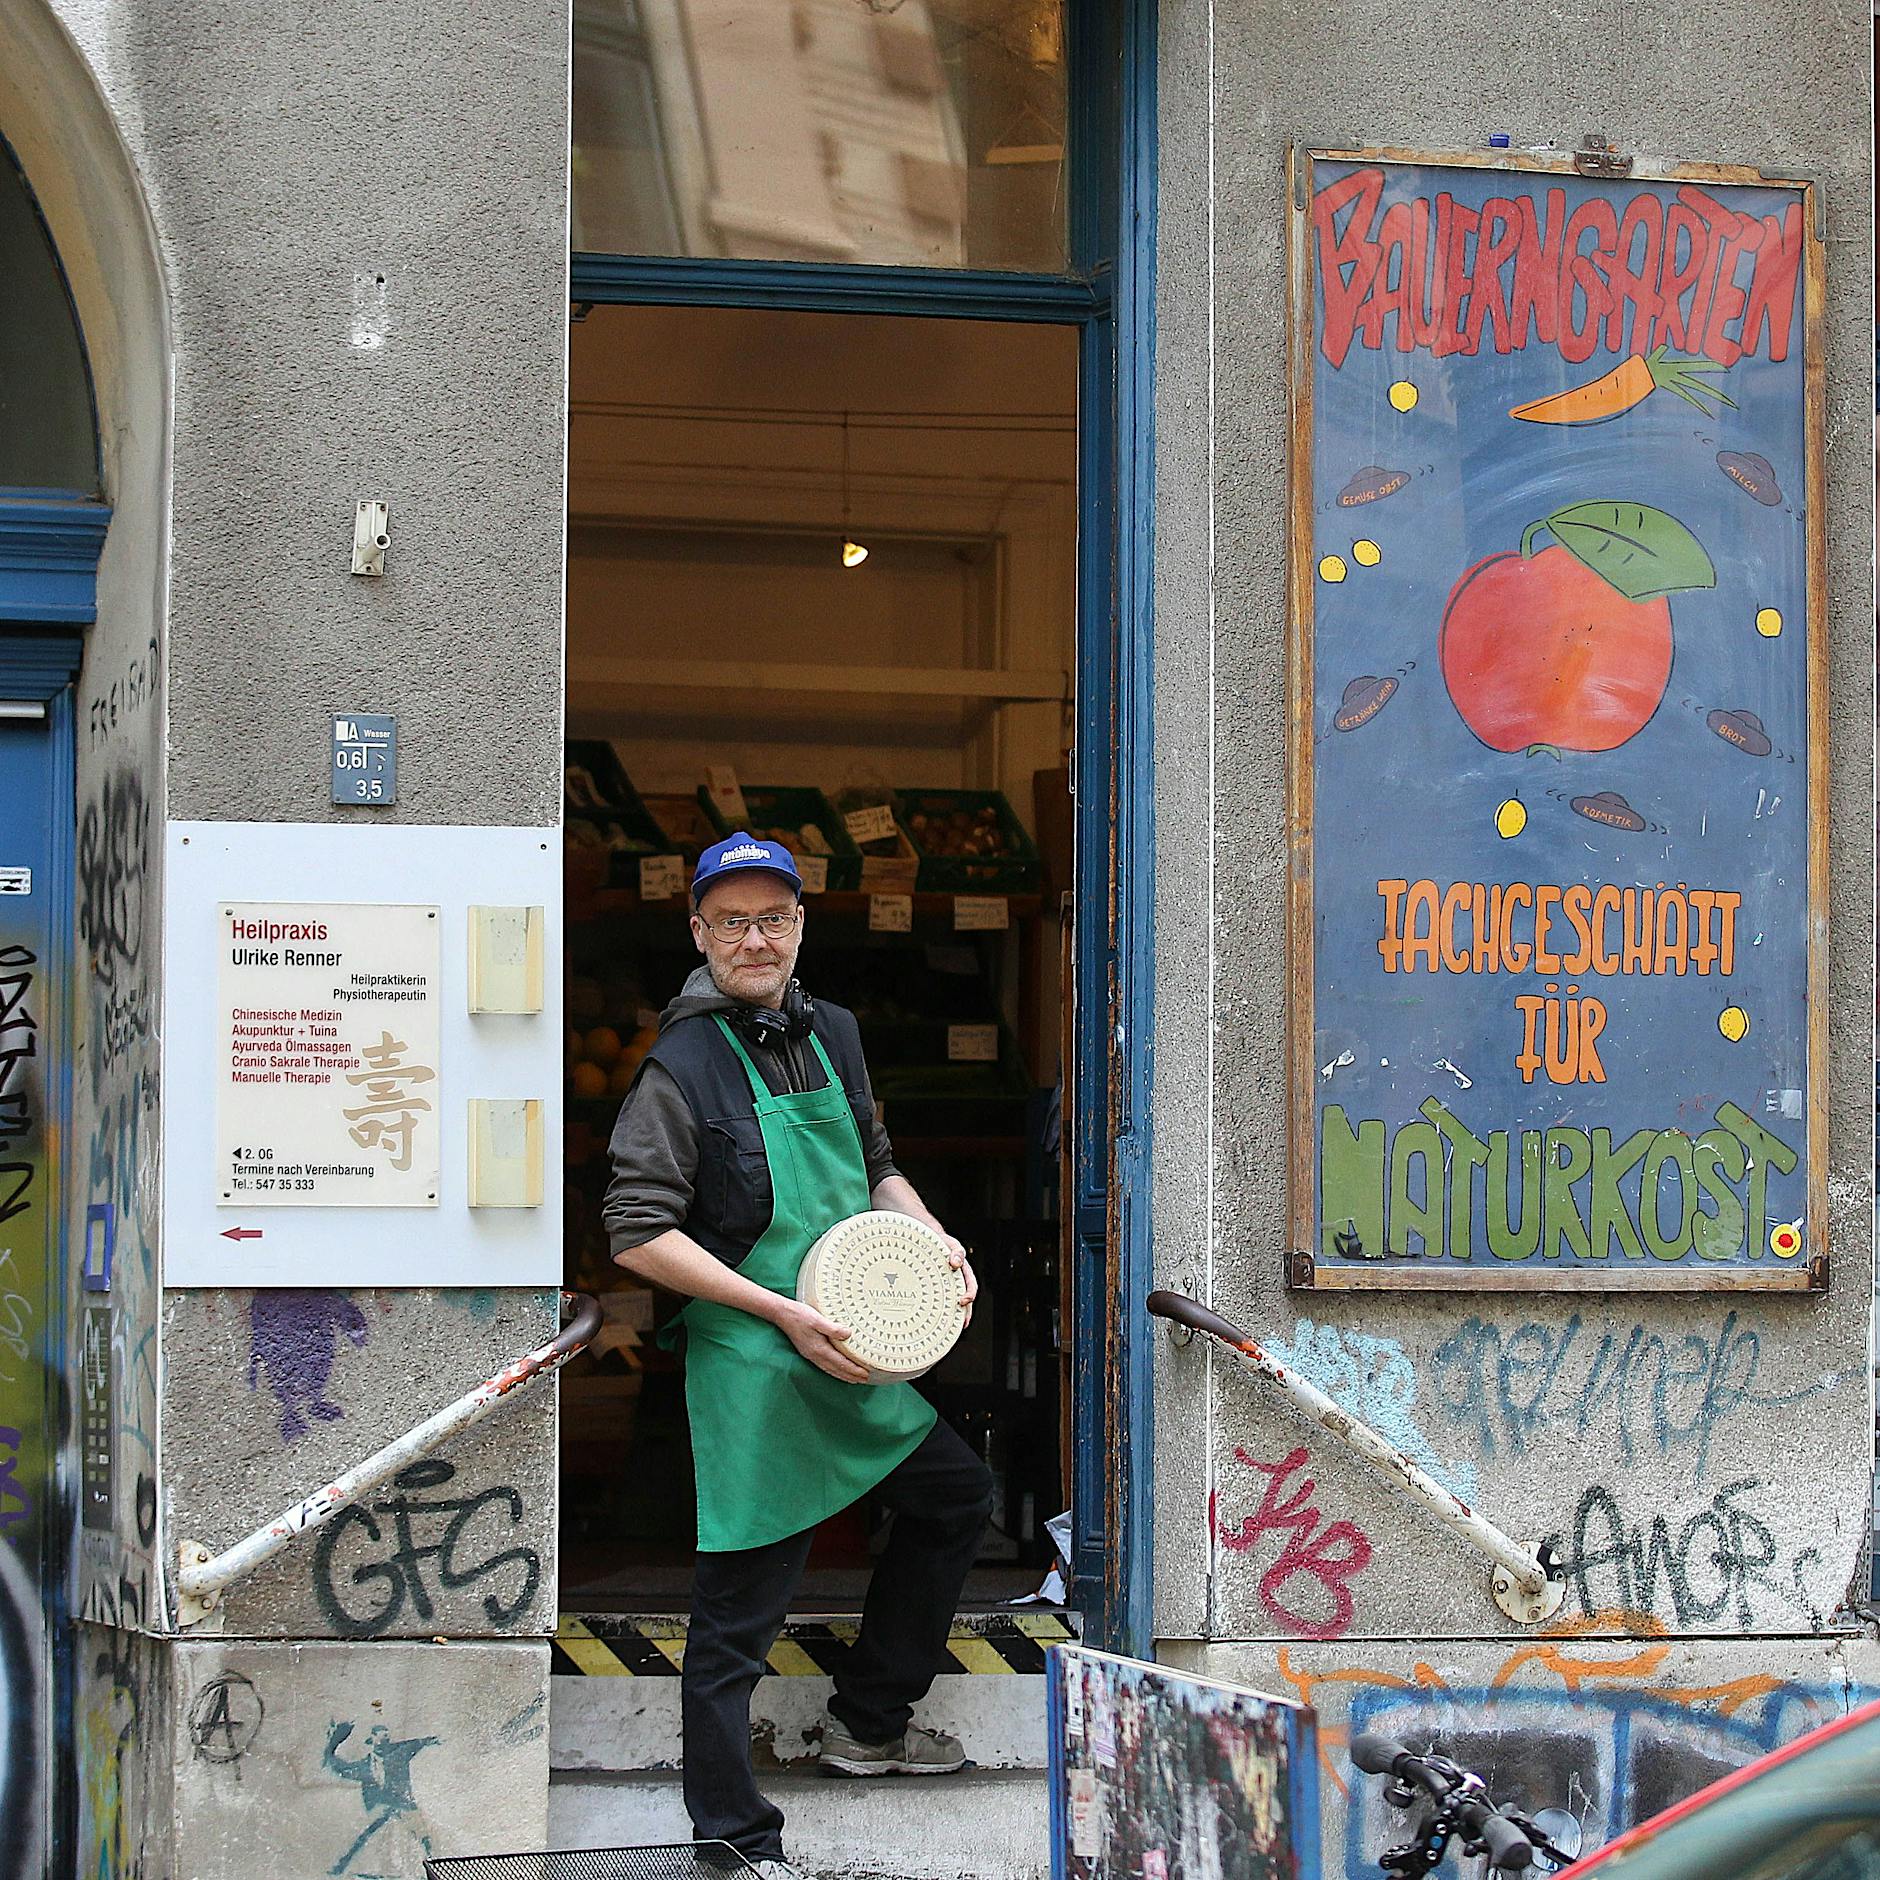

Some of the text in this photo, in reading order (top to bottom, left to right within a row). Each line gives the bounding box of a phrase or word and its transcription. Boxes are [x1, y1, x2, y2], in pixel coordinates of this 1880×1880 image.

[1314, 168, 1802, 370] BAUERNGARTEN
[1379, 476, 1401, 495] OBST
[1728, 465, 1758, 493] MILCH
[363, 729, 391, 738] Wasser
[1719, 724, 1746, 745] BROT
[336, 750, 362, 771] 0,6
[356, 779, 382, 800] 3,5
[1583, 805, 1633, 828] KOSMETIK
[232, 920, 328, 943] Heilpraxis
[232, 949, 342, 966] Ulrike Renner
[351, 974, 426, 987] Heilpraktikerin
[333, 989, 426, 1002] Physiotherapeutin
[232, 1009, 342, 1021] Chinesische Medizin
[232, 1025, 294, 1039] Akupunktur
[309, 1025, 337, 1036] Tuina
[232, 1038, 351, 1055] Ayurveda Ölmassagen
[232, 1056, 360, 1071] Cranio Sakrale Therapie
[232, 1071, 331, 1086] Manuelle Therapie
[245, 1149, 273, 1160] 2. OG
[232, 1163, 374, 1178] Termine nach Vereinbarung
[1321, 1096, 1799, 1260] NATURKOST
[232, 1179, 315, 1190] Tel.: 547 35 333
[869, 1290, 916, 1298] VIAMALA
